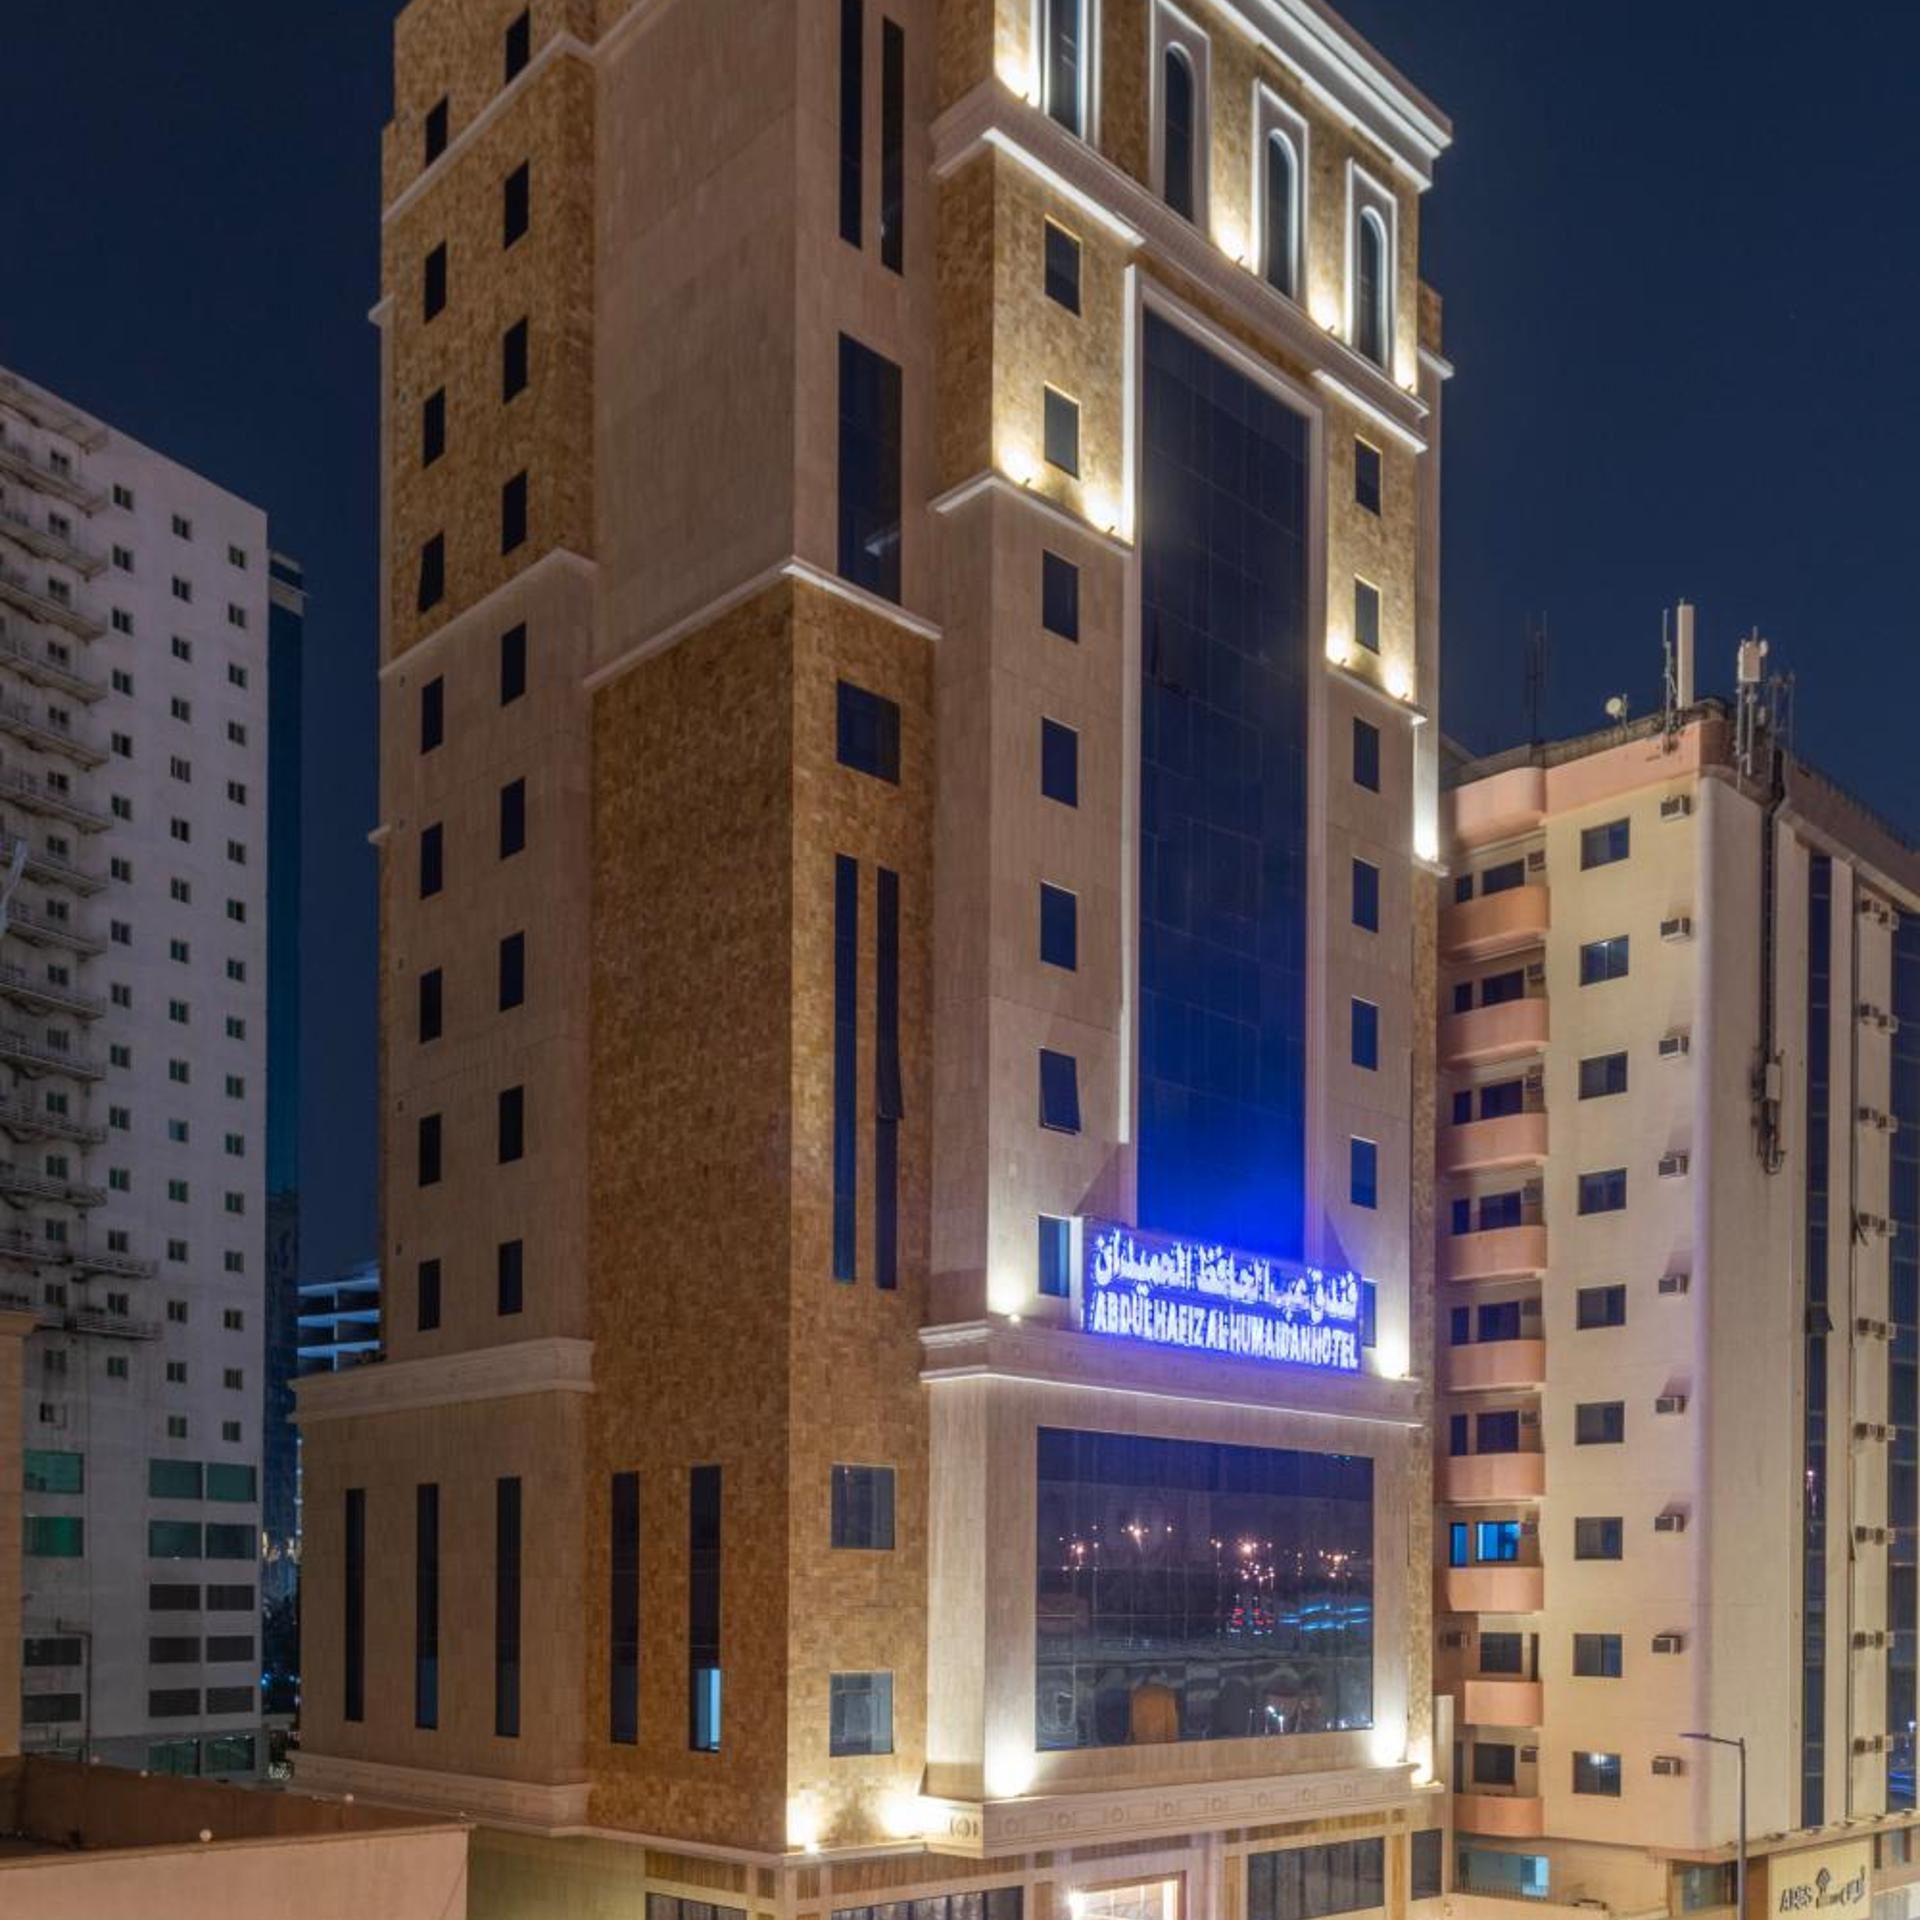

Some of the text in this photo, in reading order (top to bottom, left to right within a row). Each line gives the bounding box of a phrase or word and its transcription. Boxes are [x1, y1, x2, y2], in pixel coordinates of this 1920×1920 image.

[1093, 1289, 1153, 1341] ABDUL
[1153, 1299, 1205, 1346] HAFIZ
[1311, 1326, 1358, 1369] HOTEL
